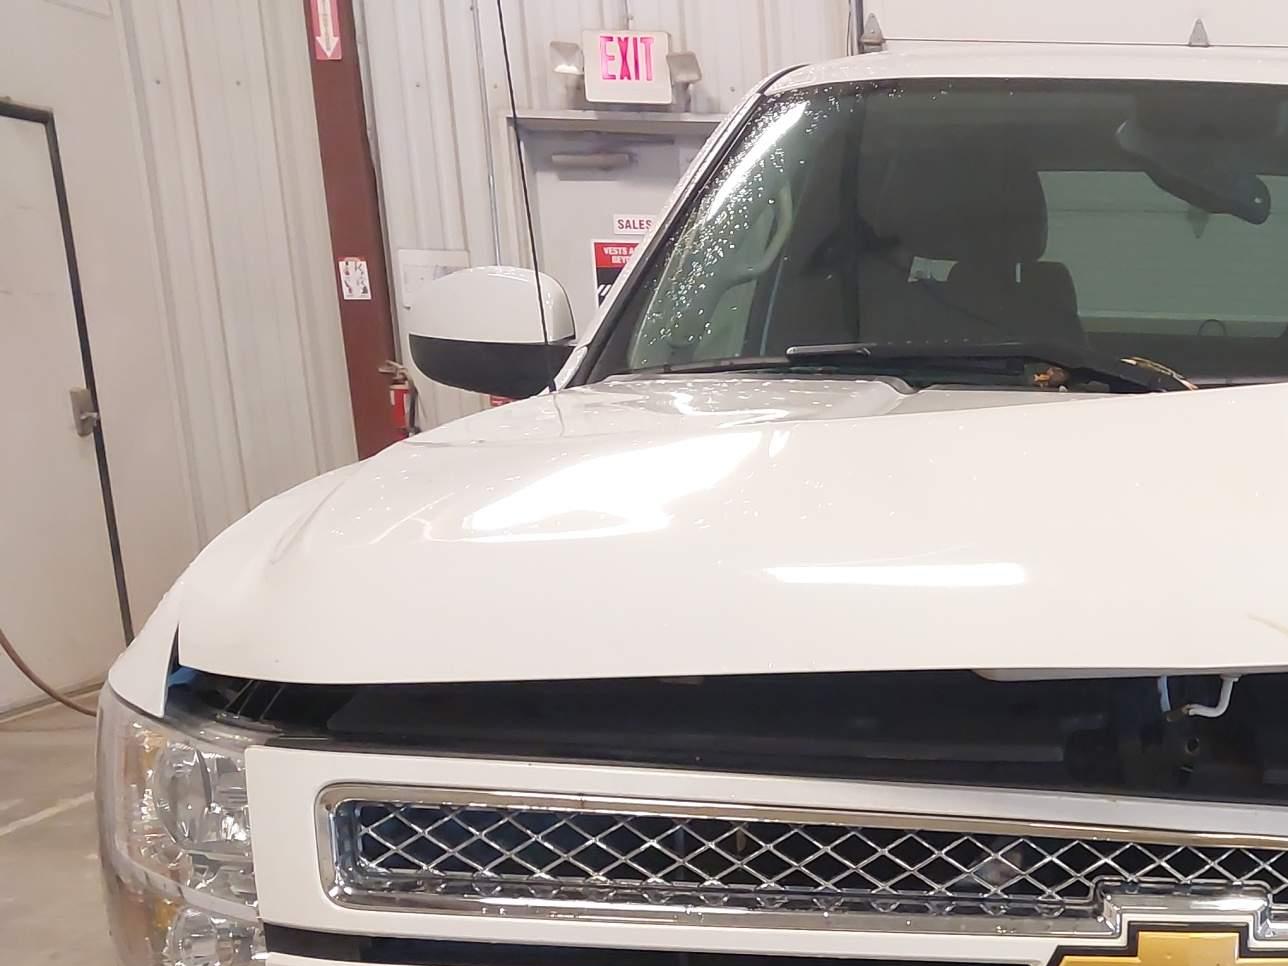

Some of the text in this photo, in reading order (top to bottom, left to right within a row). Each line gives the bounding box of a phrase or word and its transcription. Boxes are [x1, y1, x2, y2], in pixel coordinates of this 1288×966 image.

[600, 36, 654, 81] EXIT
[617, 219, 652, 230] SALES
[603, 247, 627, 255] VESTS
